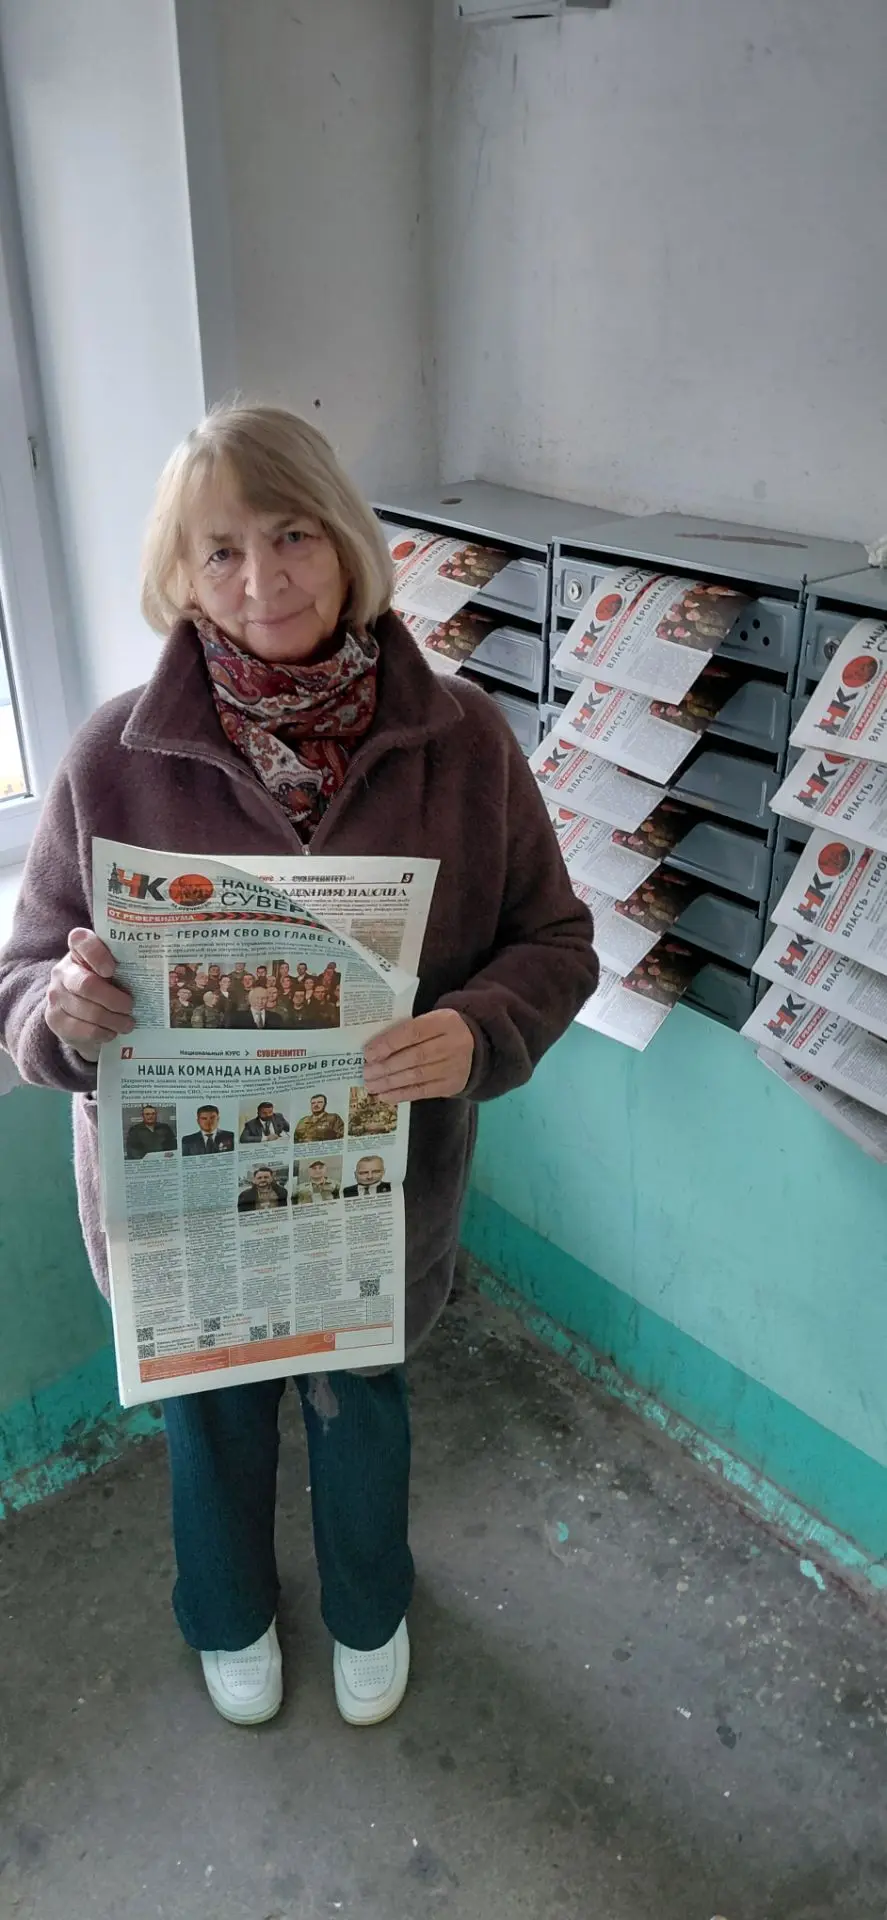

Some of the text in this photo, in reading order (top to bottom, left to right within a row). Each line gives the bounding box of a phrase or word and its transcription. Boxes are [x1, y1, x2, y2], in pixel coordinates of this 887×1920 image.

[607, 635, 632, 669] ВЛАСТЬ
[633, 592, 660, 627] ГЕРОЯМ
[602, 710, 627, 742] ВЛАСТЬ
[567, 765, 593, 793] ВЛАСТЬ
[793, 760, 839, 808] НК
[843, 783, 874, 820] ВЛАСТЬ
[565, 835, 589, 863] ВЛАСТЬ
[793, 872, 833, 923] НК
[842, 898, 868, 938] ВЛАСТЬ
[867, 854, 887, 889] ГЕРОЯ
[109, 928, 161, 942] ВЛАСТЬ
[177, 928, 229, 939] ГЕРОЯМ
[233, 928, 259, 938] СВО
[263, 929, 281, 938] ВО
[284, 930, 323, 942] ГЛАВЕ
[123, 912, 195, 922] РЕФЕРЕНДУМА
[774, 932, 815, 976] НК
[821, 955, 850, 992] ВЛАСТЬ
[763, 993, 806, 1039] НК
[256, 1048, 307, 1058] СУВЕРЕНИТЕТ!
[808, 1021, 838, 1056] ВЛАСТЬ
[137, 1064, 175, 1076] НАША
[178, 1064, 242, 1077] КОМАНДА
[244, 1065, 261, 1076] НА
[264, 1061, 318, 1076] ВЫБОРЫ
[320, 1059, 328, 1068] В
